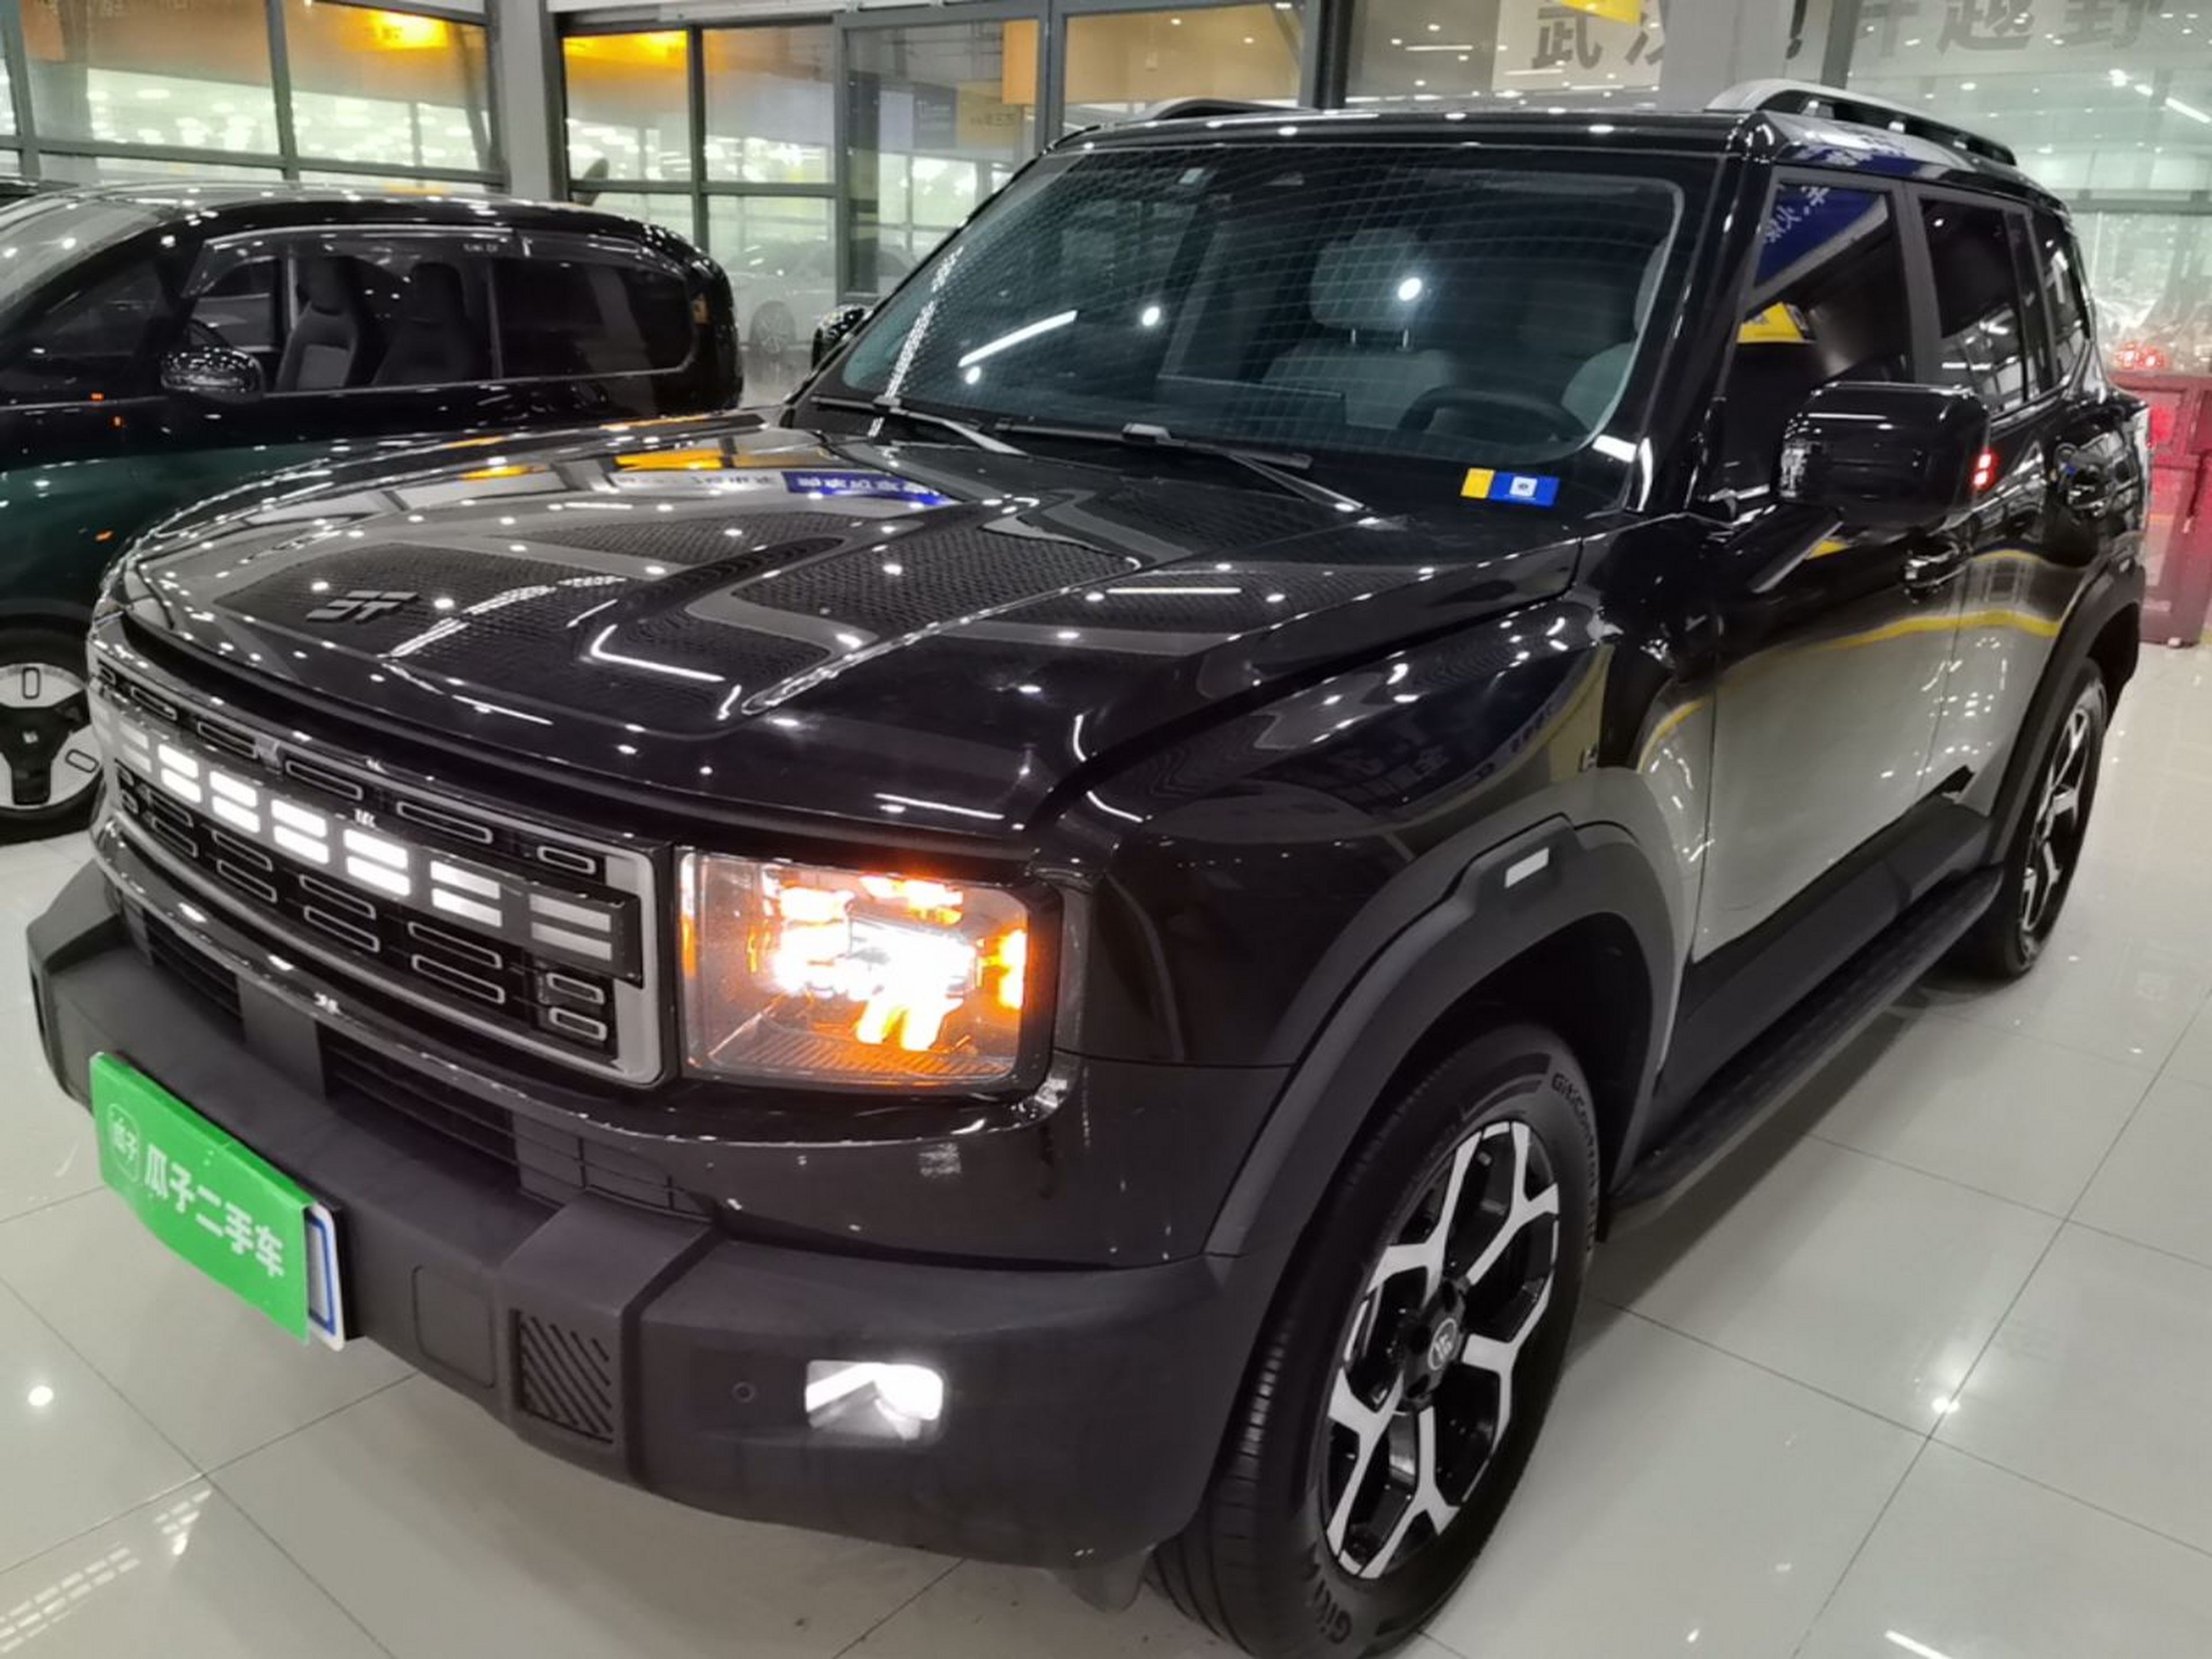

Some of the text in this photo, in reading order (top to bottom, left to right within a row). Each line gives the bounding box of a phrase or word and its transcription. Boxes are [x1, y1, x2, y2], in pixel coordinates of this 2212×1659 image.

[144, 1143, 285, 1278] 瓜子二手车
